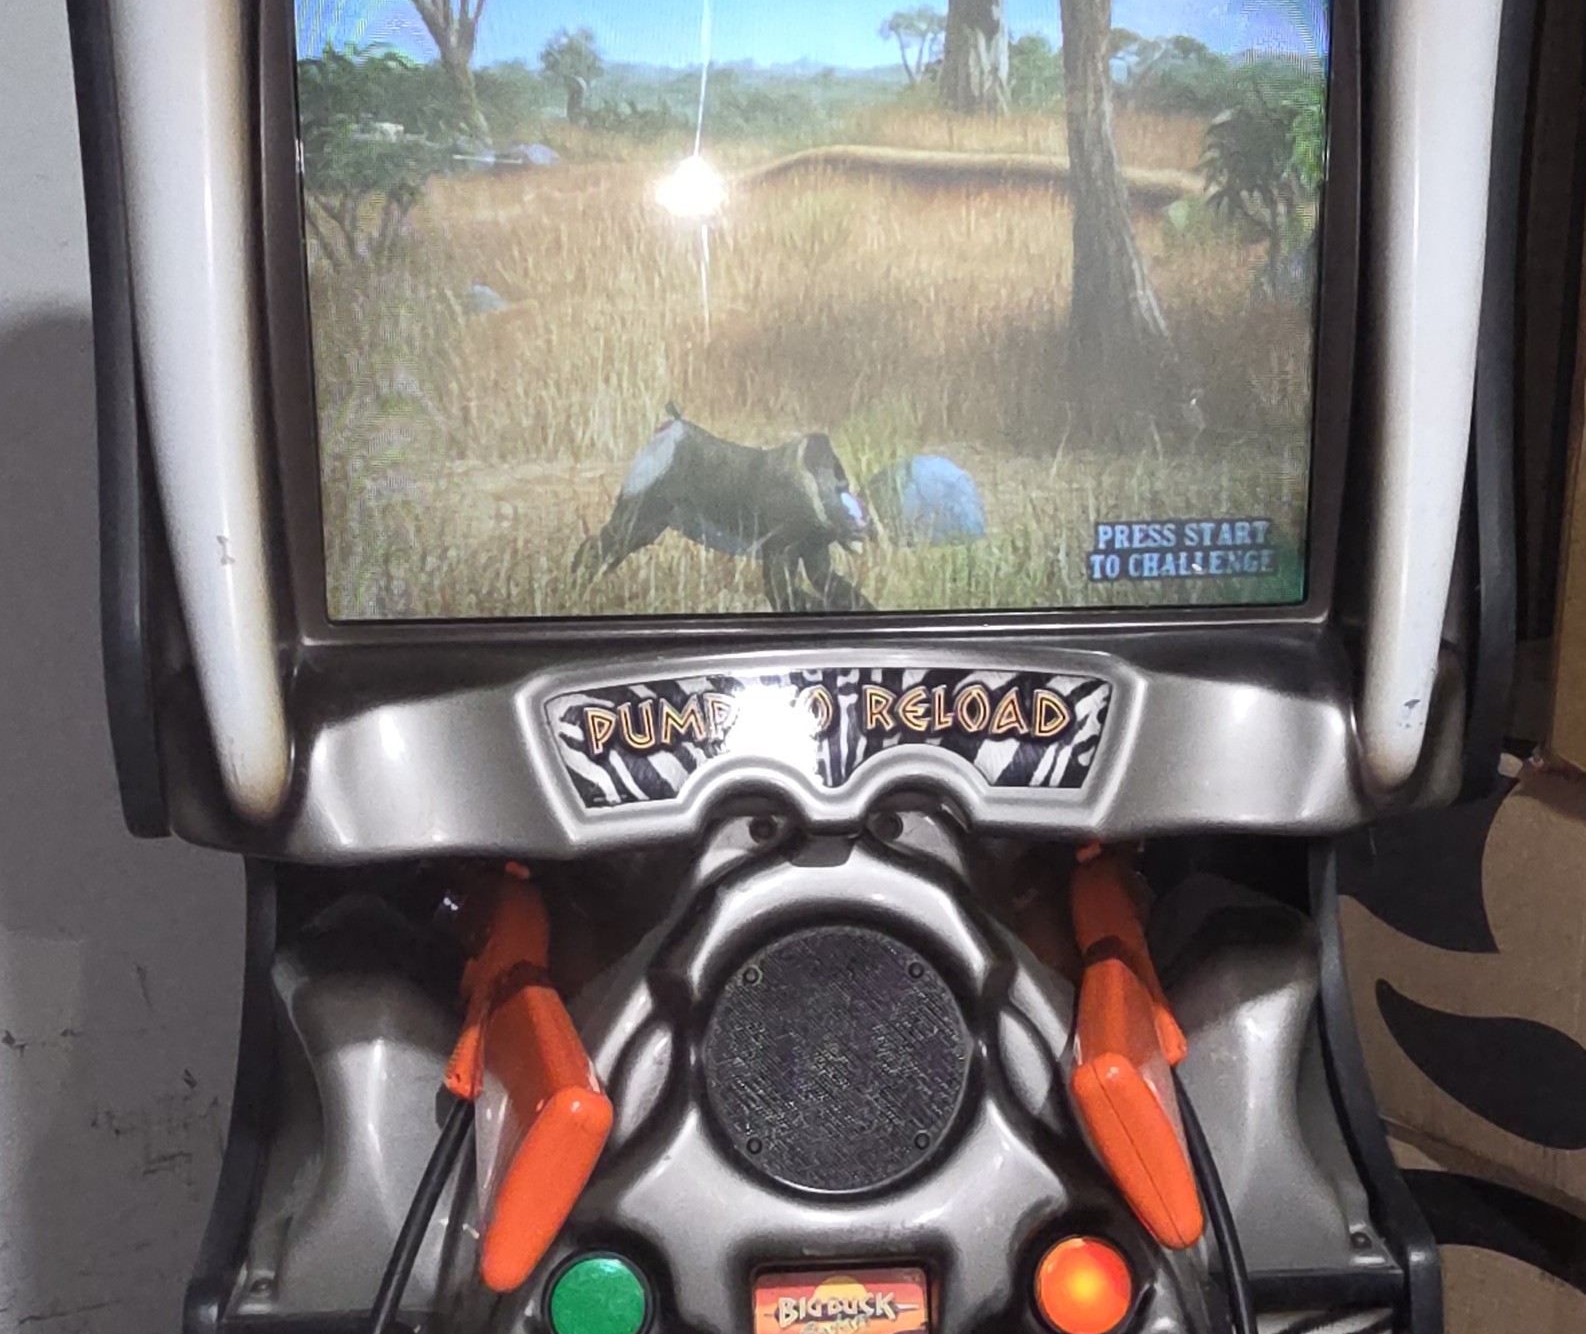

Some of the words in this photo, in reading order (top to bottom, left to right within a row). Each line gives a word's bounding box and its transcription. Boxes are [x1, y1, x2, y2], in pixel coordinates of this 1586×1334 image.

[1097, 523, 1176, 550] PRESS
[1184, 520, 1270, 547] START
[1090, 554, 1120, 579] TO
[1128, 550, 1275, 578] CHALLENGE
[584, 692, 740, 756] PUMP
[864, 683, 1070, 737] RELOAD
[778, 1297, 822, 1329] BIG
